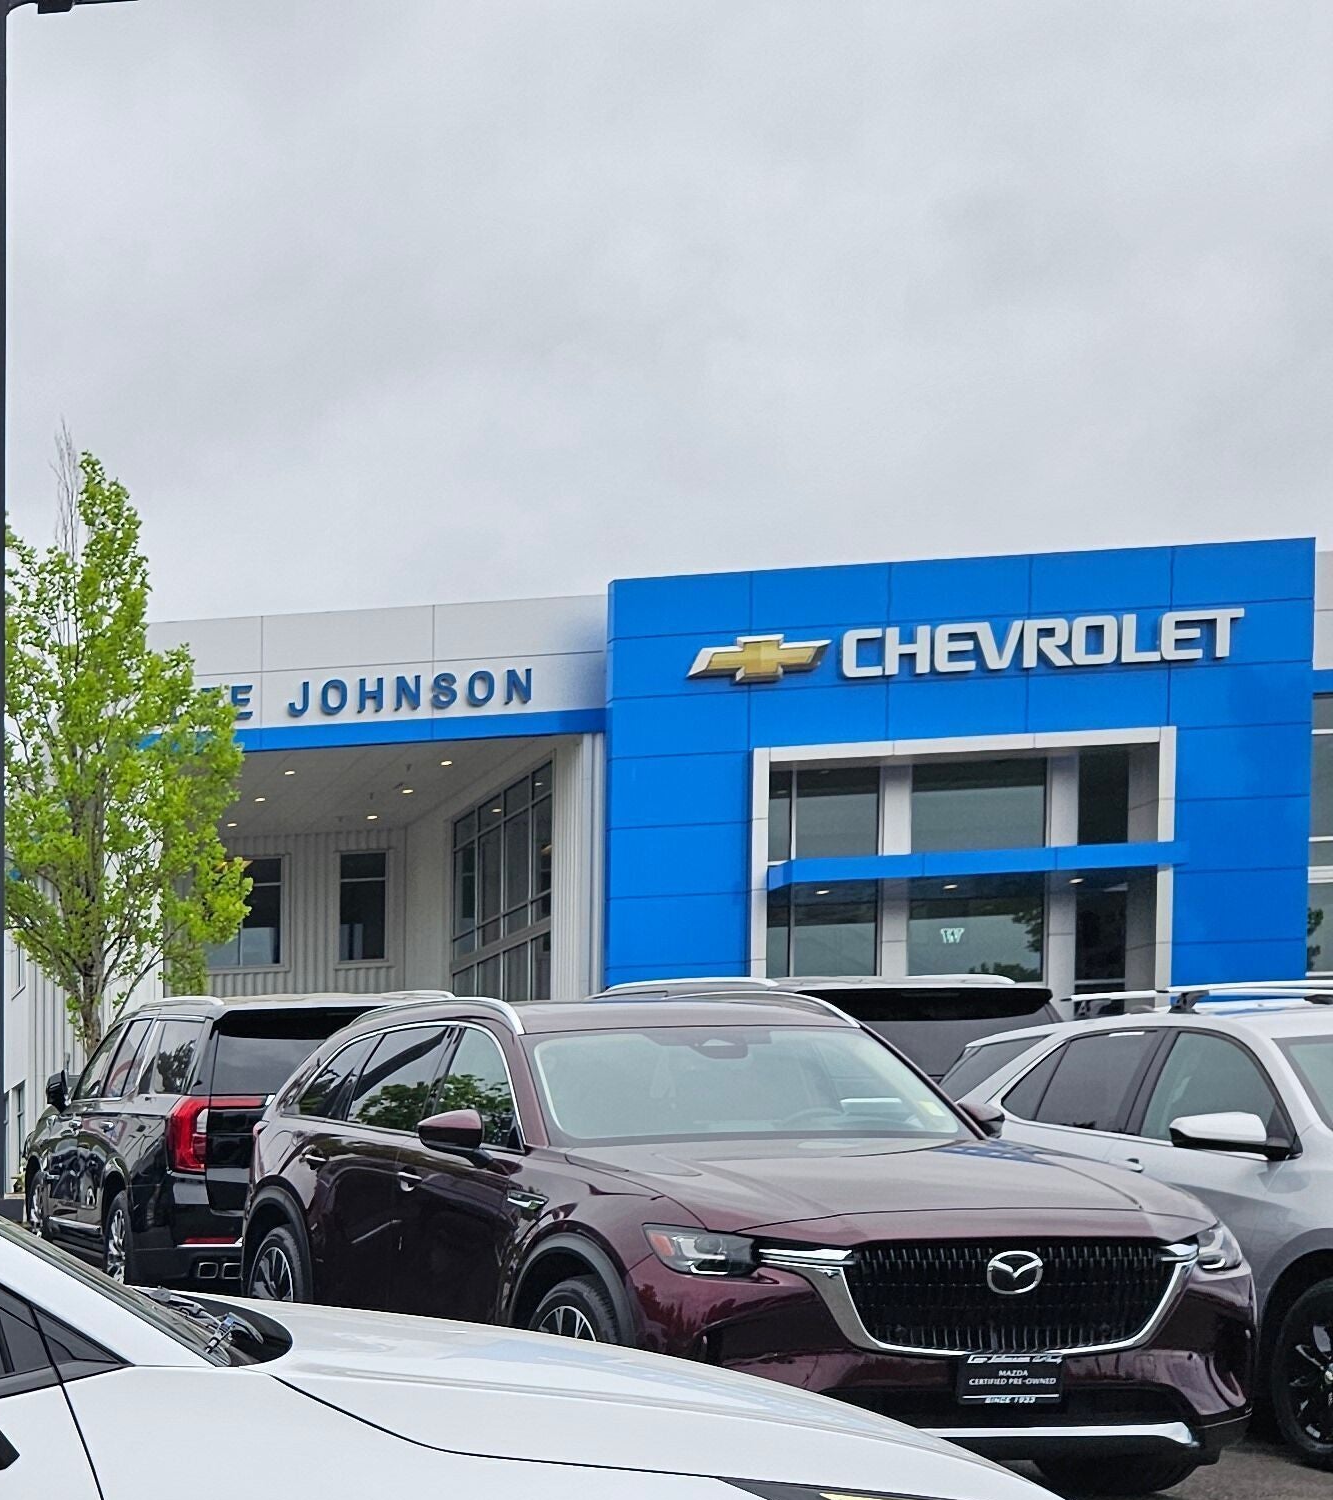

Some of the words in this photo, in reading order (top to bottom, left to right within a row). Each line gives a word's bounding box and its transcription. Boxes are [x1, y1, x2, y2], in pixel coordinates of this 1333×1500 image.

[842, 607, 1246, 678] CHEVROLET
[288, 667, 533, 718] JOHNSON
[968, 1378, 1007, 1386] CERTIFIED
[1008, 1377, 1057, 1386] PRE-OWNED
[998, 1369, 1028, 1377] MAZDA
